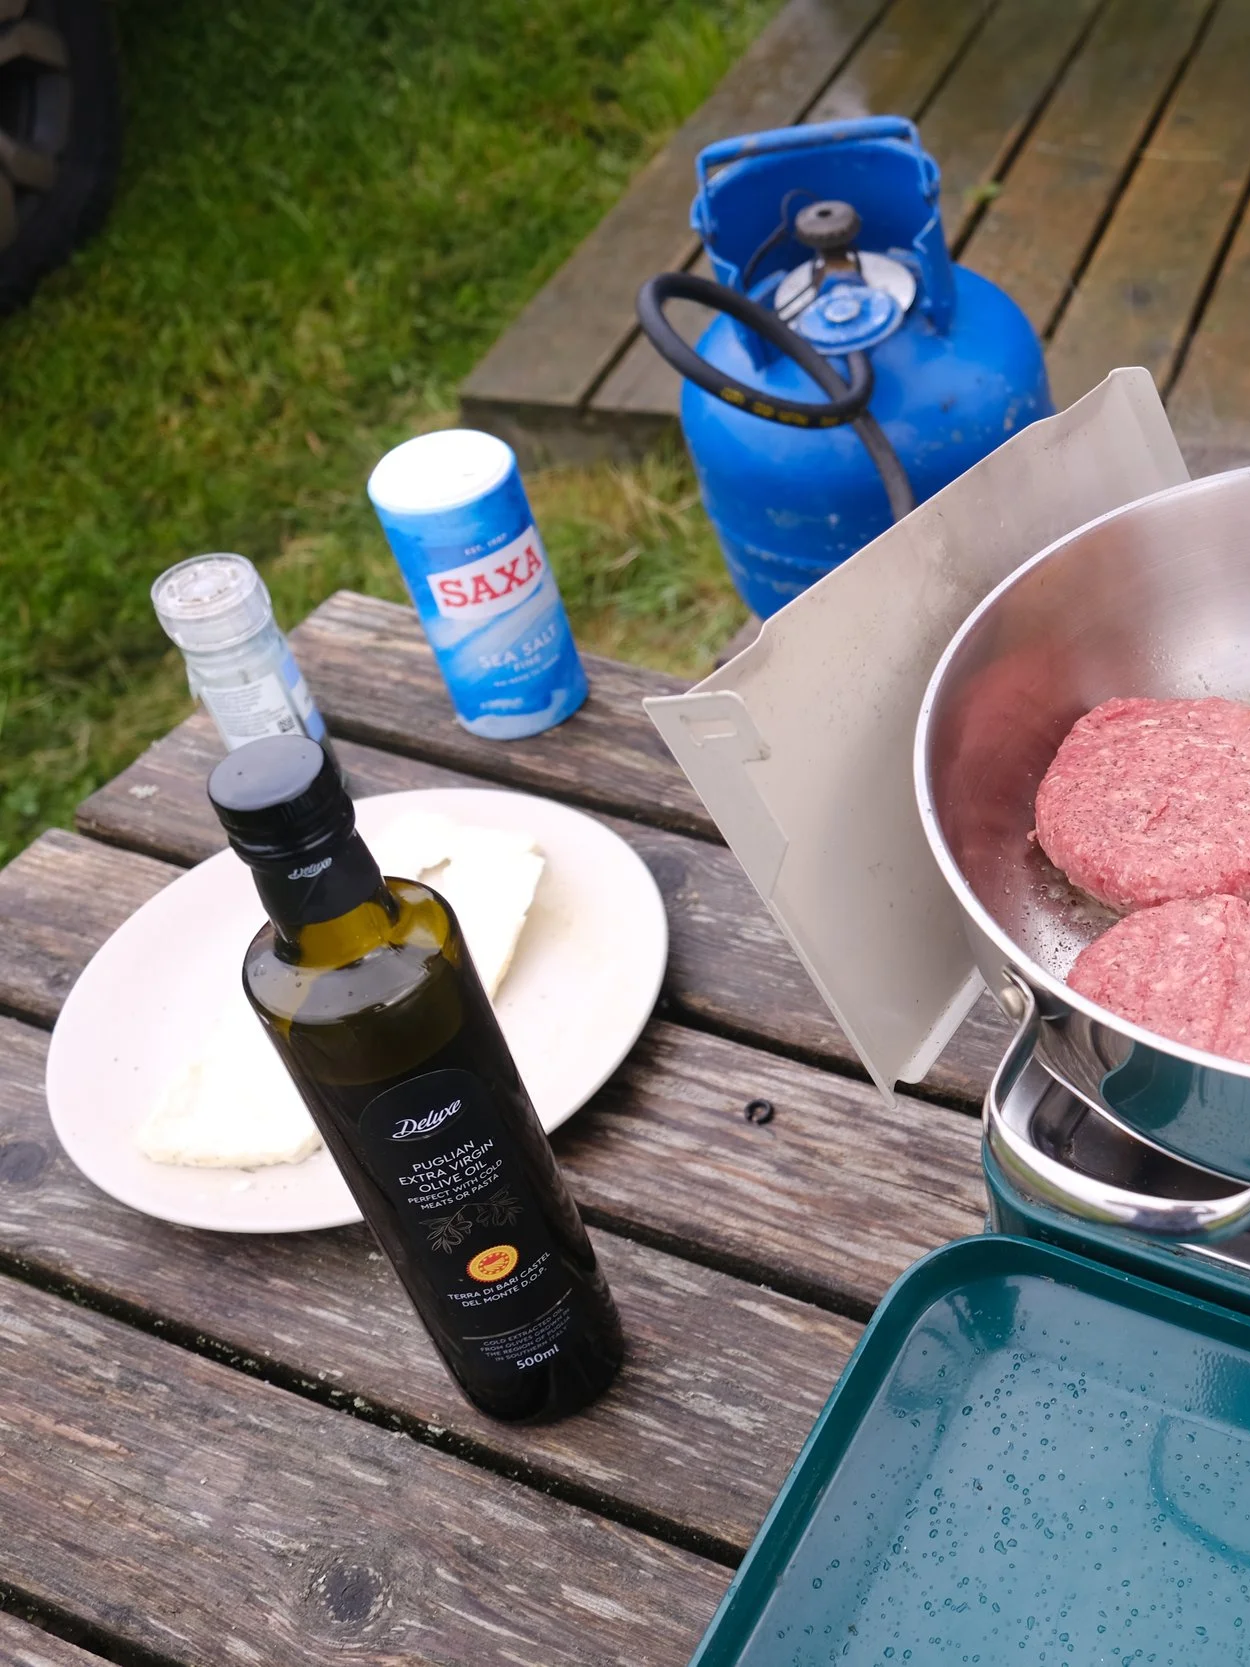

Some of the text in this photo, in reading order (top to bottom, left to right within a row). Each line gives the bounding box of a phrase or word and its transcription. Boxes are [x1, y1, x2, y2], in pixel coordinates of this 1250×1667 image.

[438, 544, 542, 608] SAXA
[478, 623, 556, 669] SEA SALT
[514, 654, 541, 672] FINE
[287, 857, 333, 880] Deluxe
[392, 1099, 462, 1139] Deluxe
[399, 1139, 494, 1186] EXTRA VIRGIN
[412, 1140, 475, 1172] PUGLIAN
[407, 1159, 503, 1204] PERFECT WITH COLD
[419, 1160, 488, 1193] OLIVE OIL
[420, 1173, 499, 1210] MEATS OR PASTA
[447, 1251, 551, 1300] TERRA DI BARI CASTEL
[461, 1266, 547, 1308] DEL MONTE D.O.P.
[483, 1338, 506, 1347] COLD
[508, 1316, 552, 1342] EXTRACTED
[503, 1341, 534, 1354] REGION
[535, 1334, 545, 1343] OF
[546, 1316, 571, 1337] PUGLIA
[505, 1335, 533, 1349] OLIVES
[534, 1315, 563, 1337] GROWN
[505, 1340, 548, 1360] SOUTHERN
[548, 1326, 568, 1342] ITALY
[516, 1343, 560, 1370] 500ml
